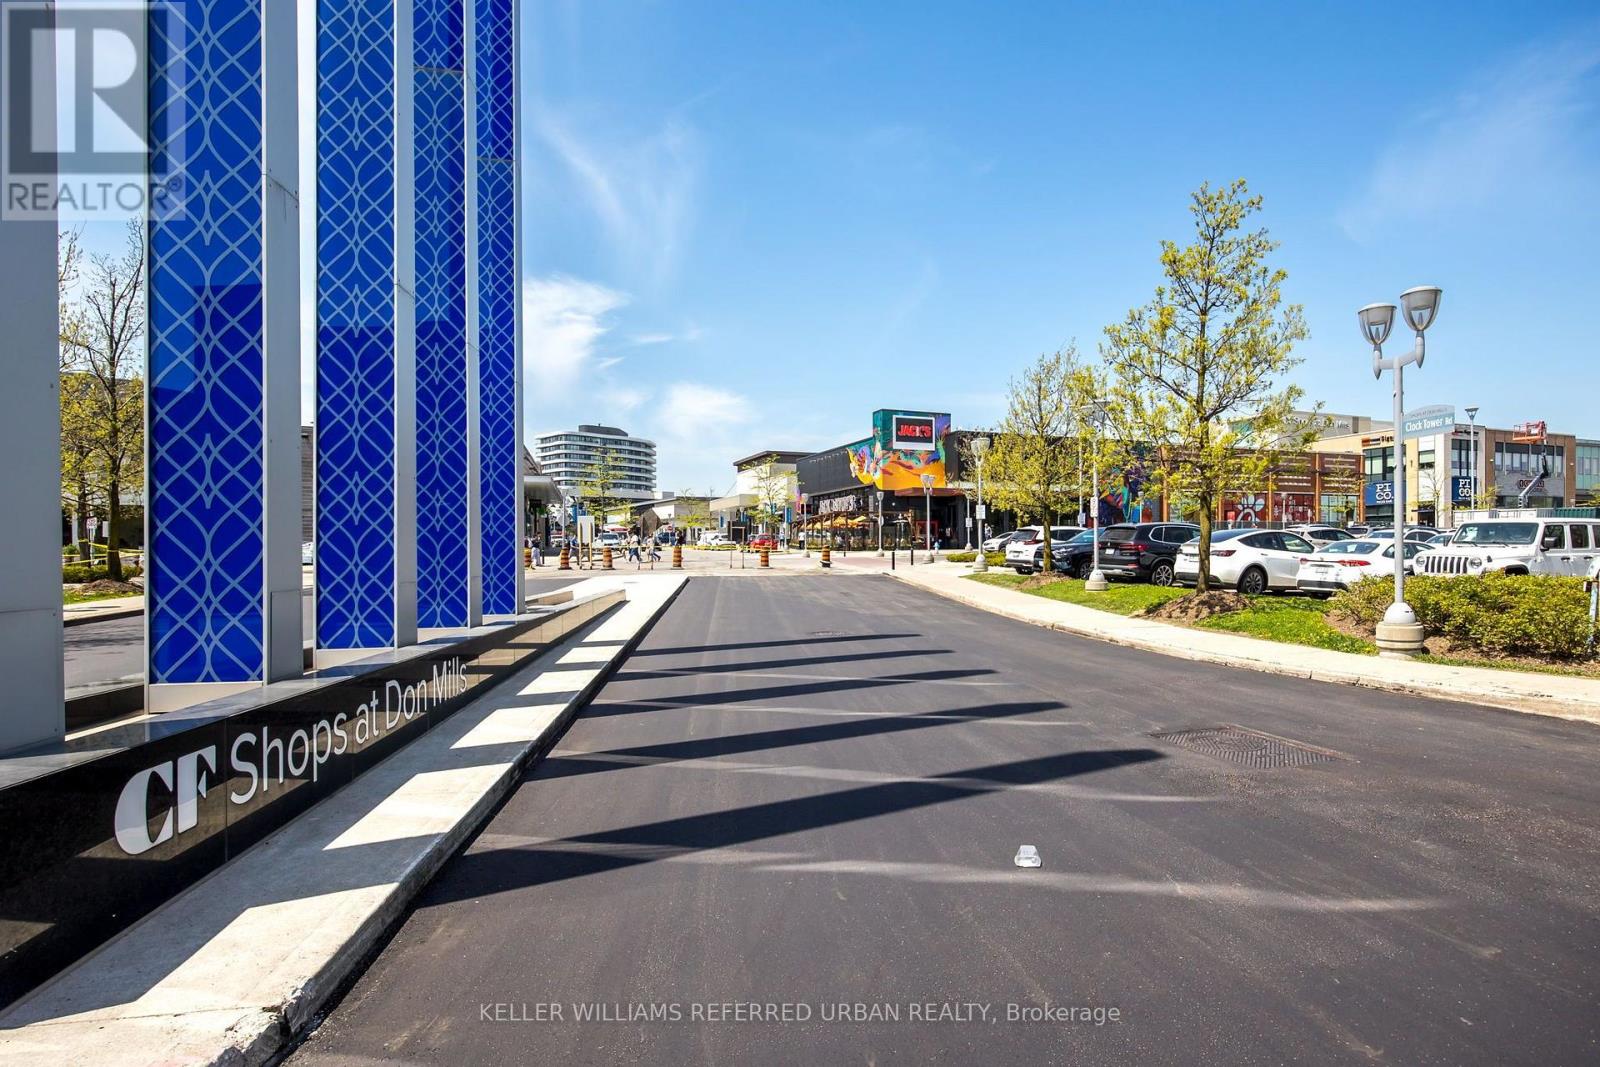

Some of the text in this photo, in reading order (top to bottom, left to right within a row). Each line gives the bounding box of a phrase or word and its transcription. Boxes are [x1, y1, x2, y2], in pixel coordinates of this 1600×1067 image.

[1405, 416, 1453, 432] Clock Tower Rd
[897, 424, 932, 437] JACK'S
[1376, 483, 1391, 492] PI
[1459, 479, 1470, 488] PI
[1376, 491, 1394, 500] CO.
[114, 656, 467, 855] CF Shops at Don Mills
